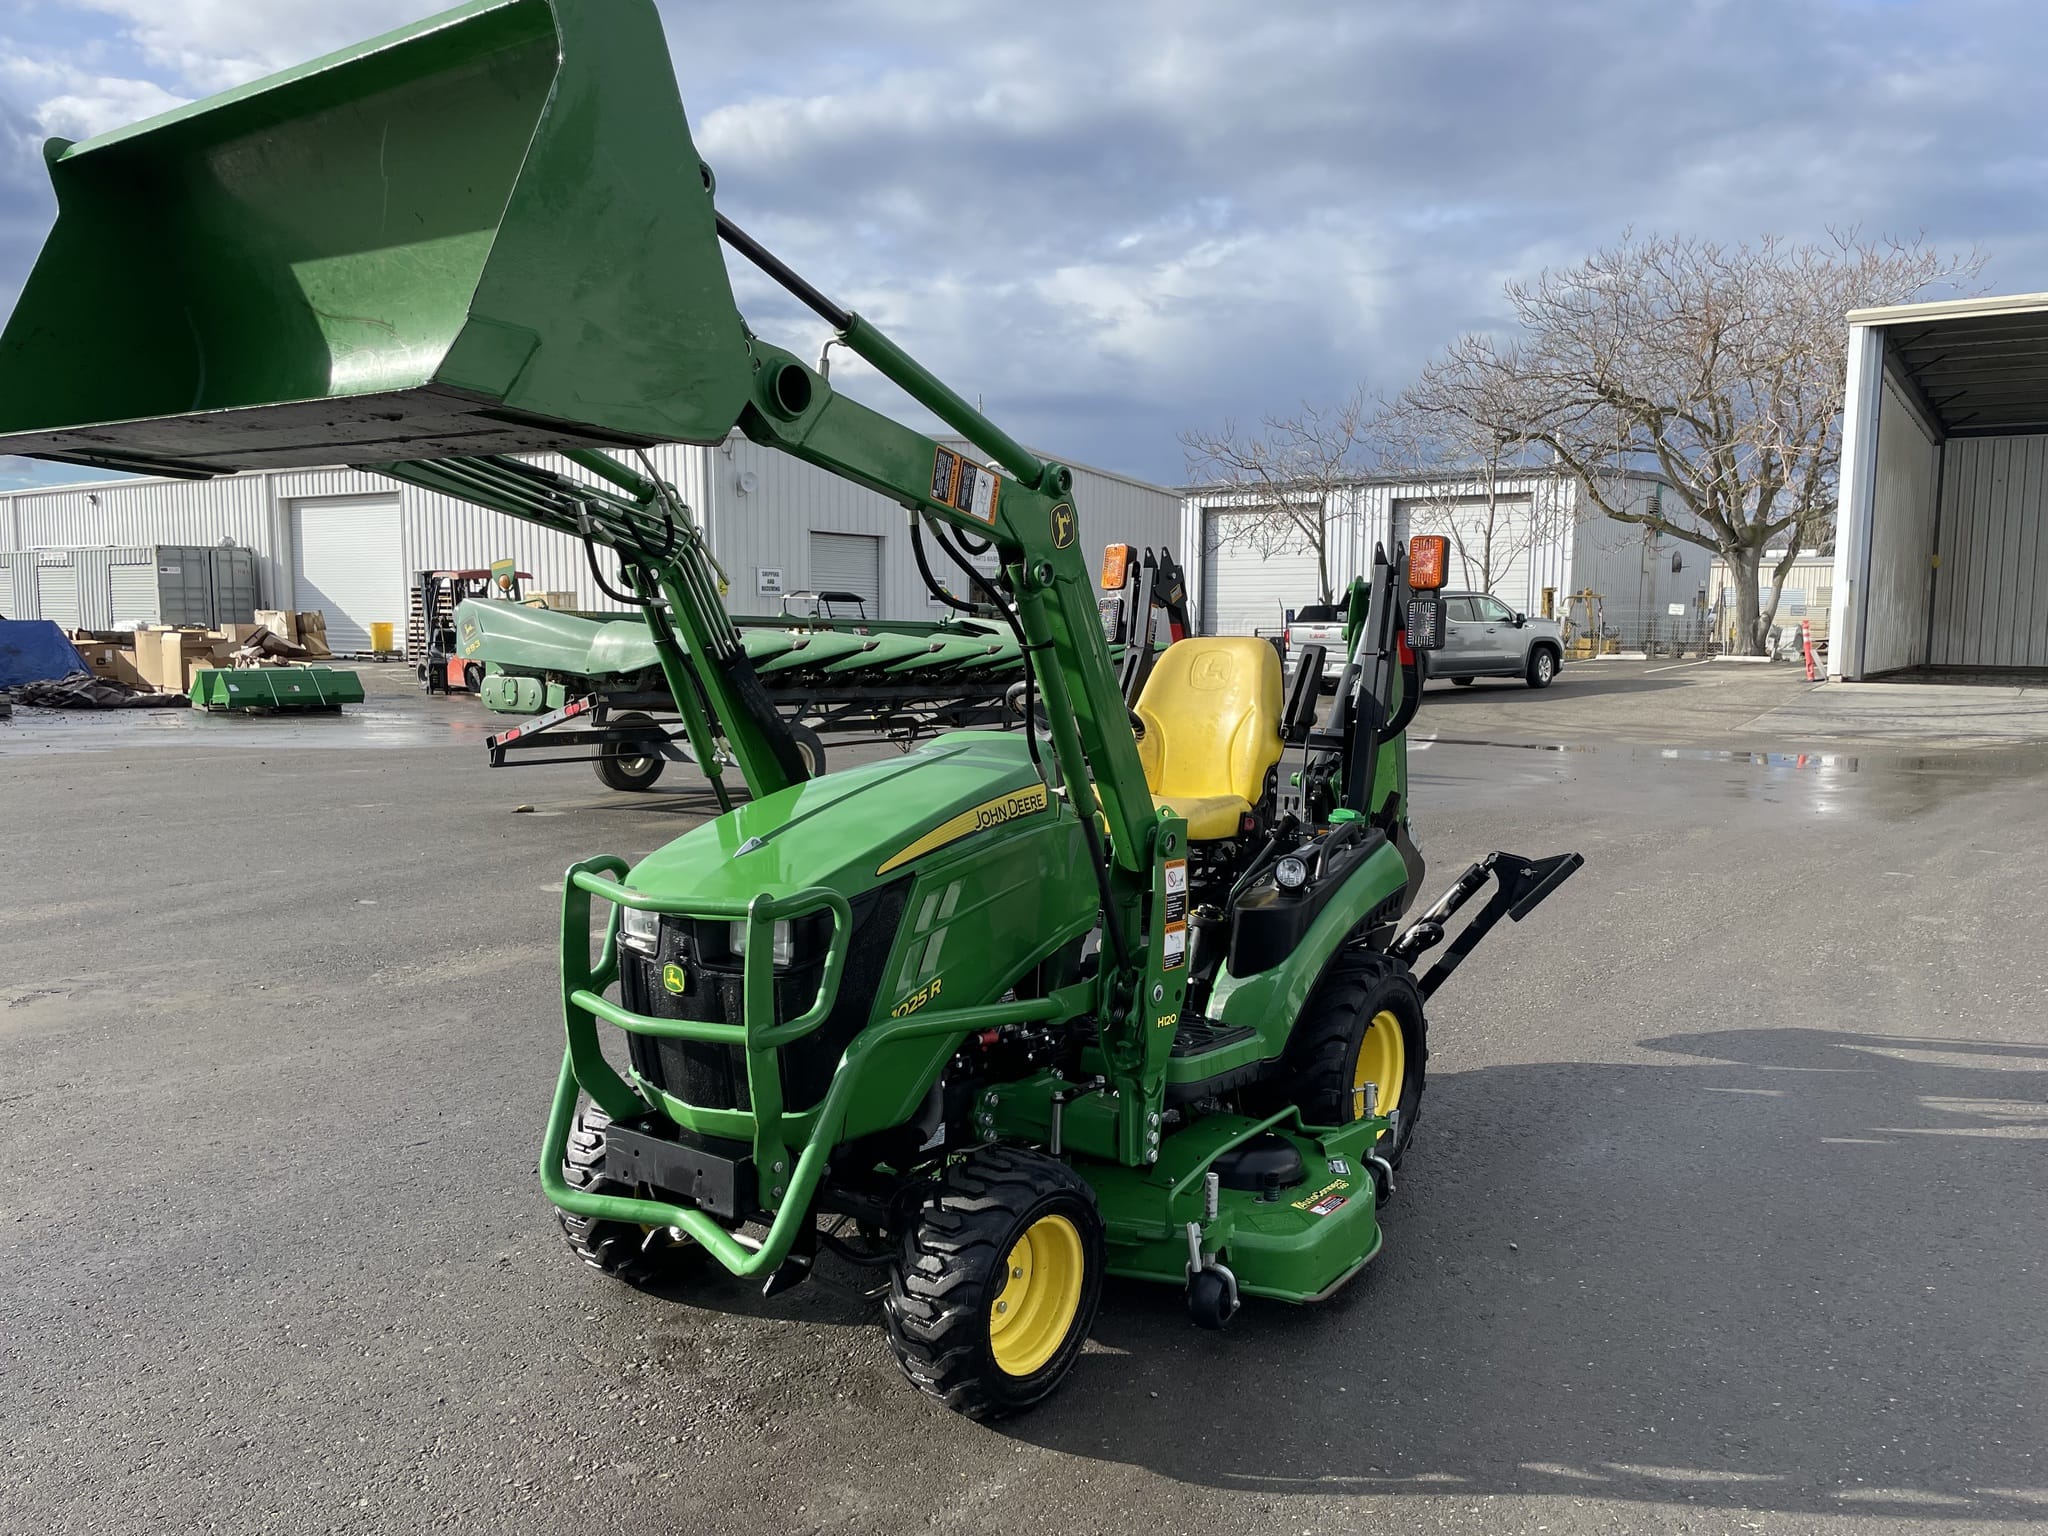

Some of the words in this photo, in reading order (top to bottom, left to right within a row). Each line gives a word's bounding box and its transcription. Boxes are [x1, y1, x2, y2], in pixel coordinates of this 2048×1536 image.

[975, 804, 1008, 831] JOHN
[1007, 793, 1045, 818] DEERE
[930, 979, 942, 999] R
[1157, 1013, 1177, 1029] H120
